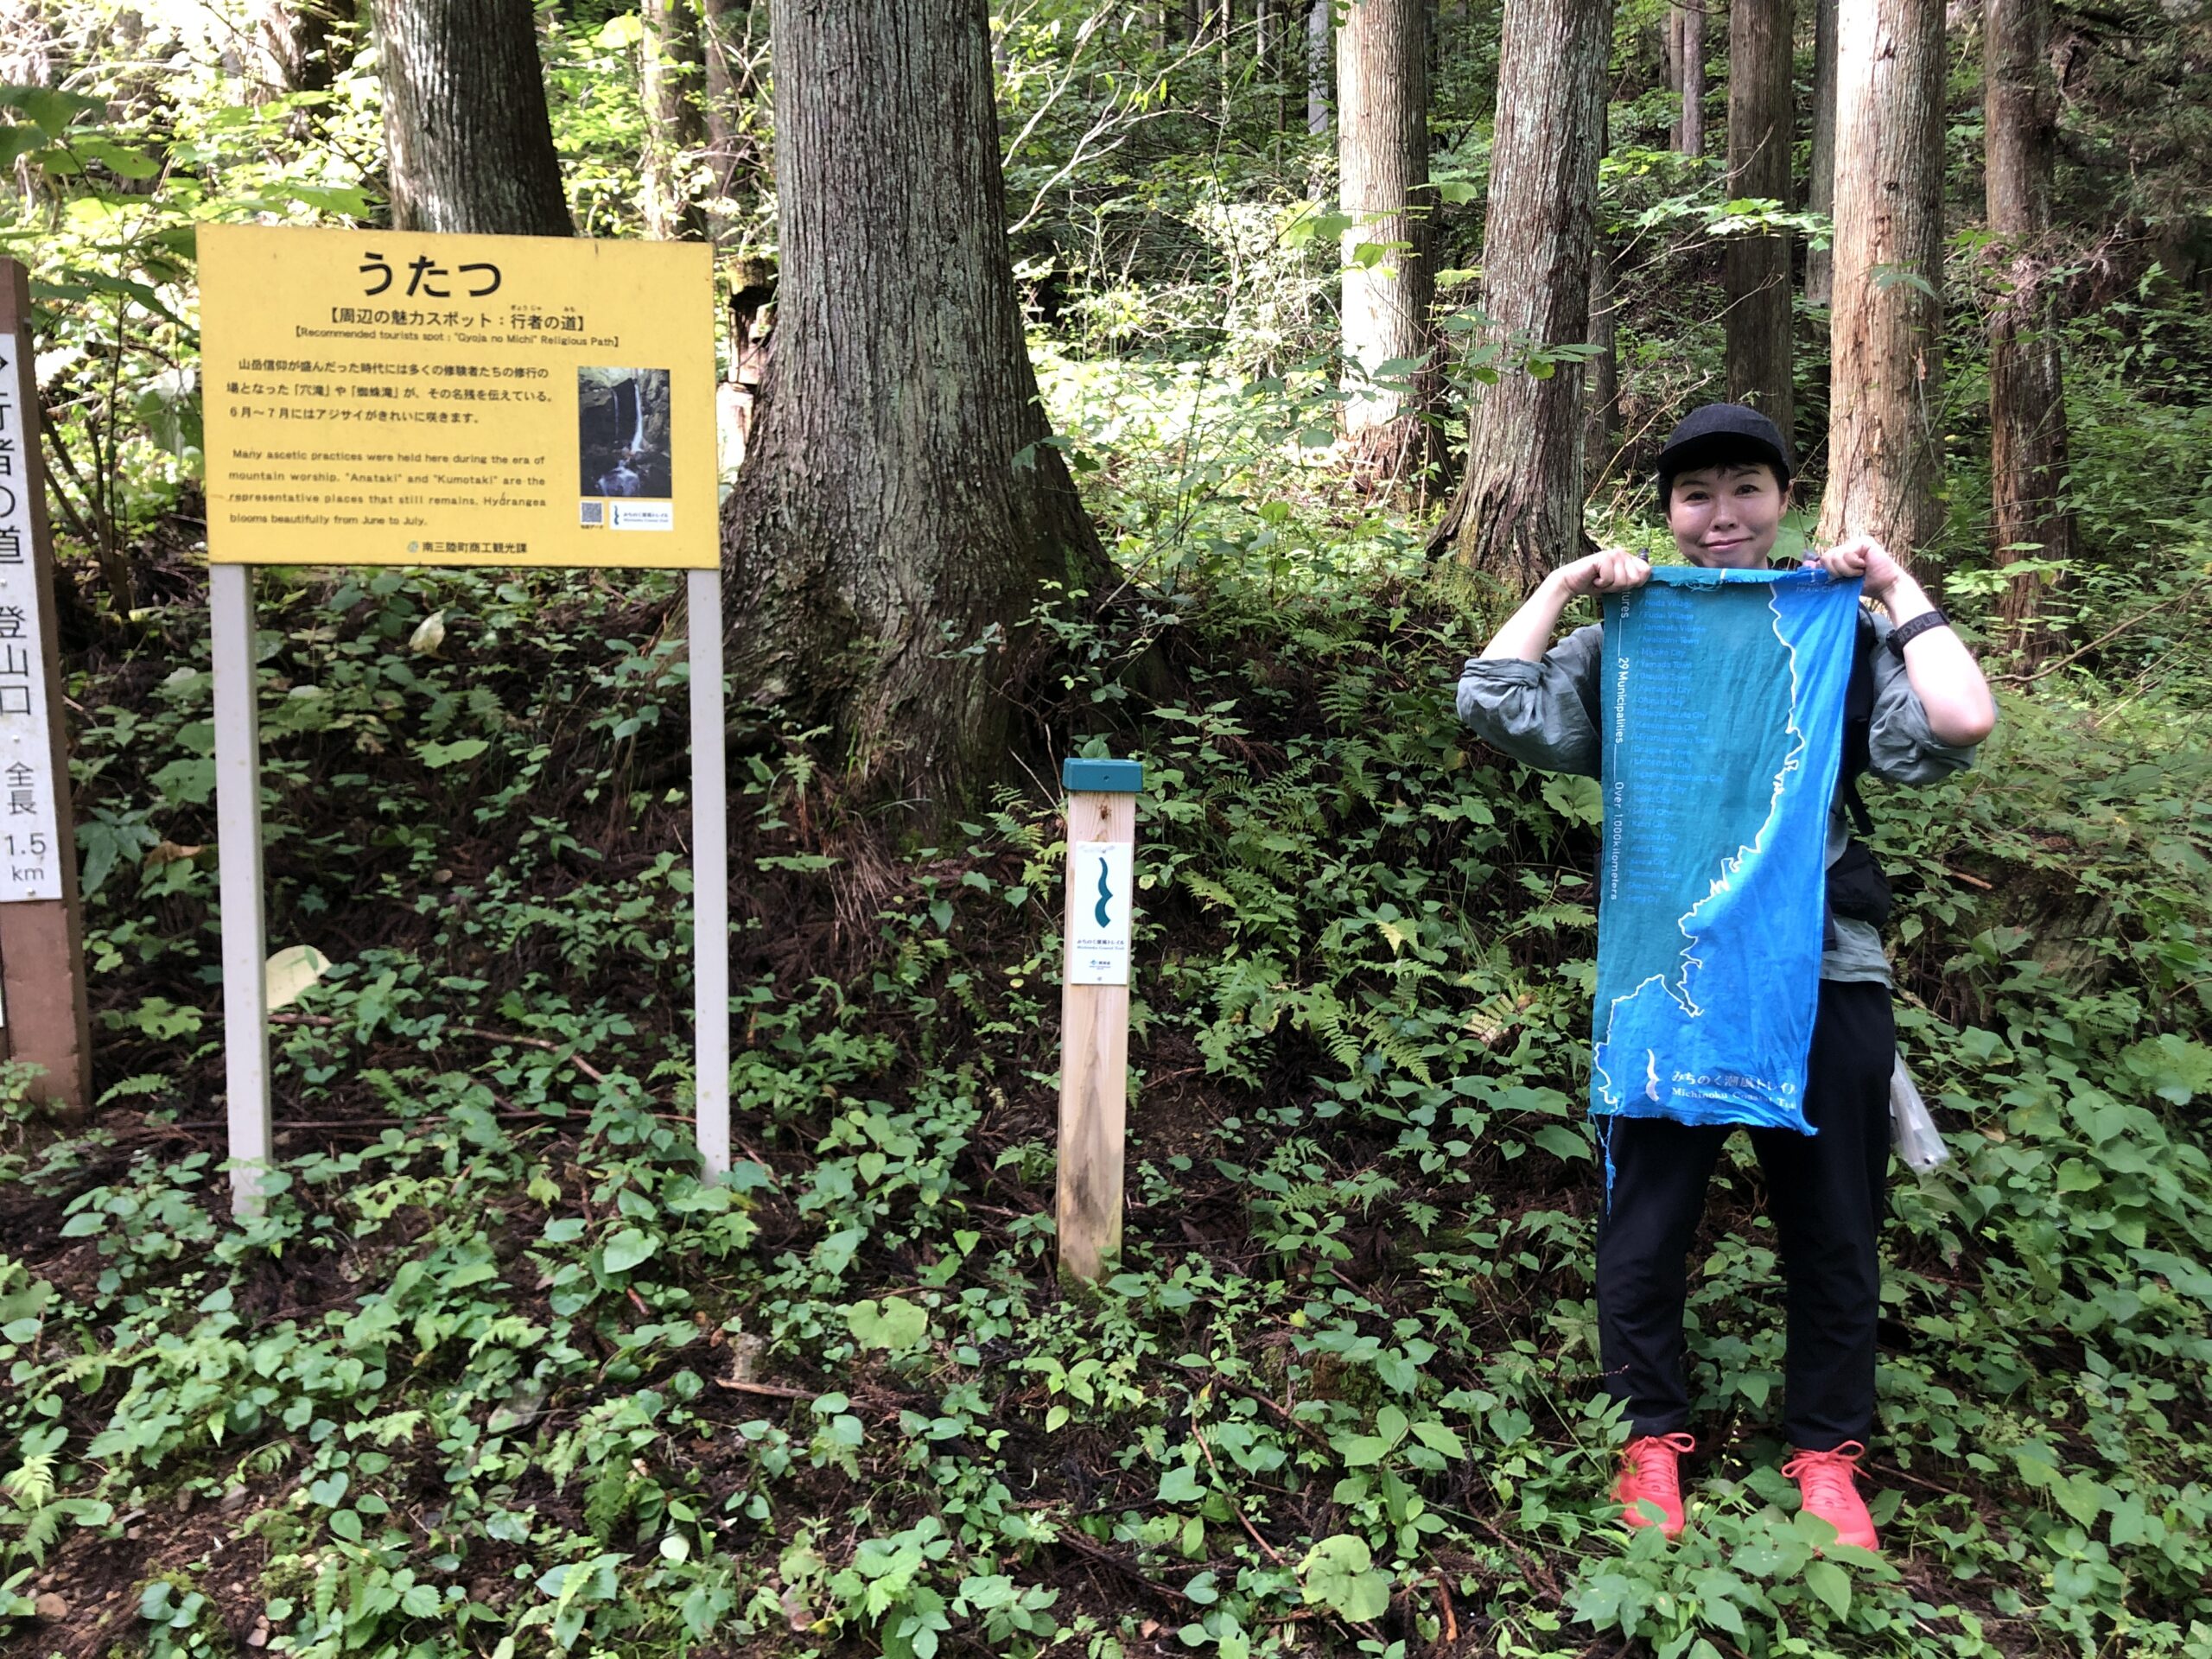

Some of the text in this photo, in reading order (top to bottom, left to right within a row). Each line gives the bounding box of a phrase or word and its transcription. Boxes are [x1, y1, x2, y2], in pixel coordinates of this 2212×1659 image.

[359, 251, 502, 297] うたつ
[379, 330, 419, 340] tourists
[423, 332, 444, 341] spot
[491, 334, 504, 343] no
[541, 335, 588, 346] Religious
[232, 448, 545, 465] Many ascetic practices were held here during the era of
[228, 471, 285, 481] mountain
[289, 472, 340, 483] worship.
[407, 474, 429, 484] and
[502, 477, 522, 486] are
[526, 476, 545, 486] the
[228, 492, 546, 507] representative places that still remains. Hydrangea
[229, 513, 429, 526] blooms beautifully from June to July.
[423, 541, 528, 554] 南三陸町商工観光課
[1618, 657, 1630, 670] 29
[1613, 671, 1630, 744] Municipalities
[5, 760, 37, 816] 全長
[1613, 781, 1624, 809] Over
[3, 831, 48, 857] 1.5
[11, 865, 45, 882] km
[1672, 1087, 1728, 1100] Michinoku
